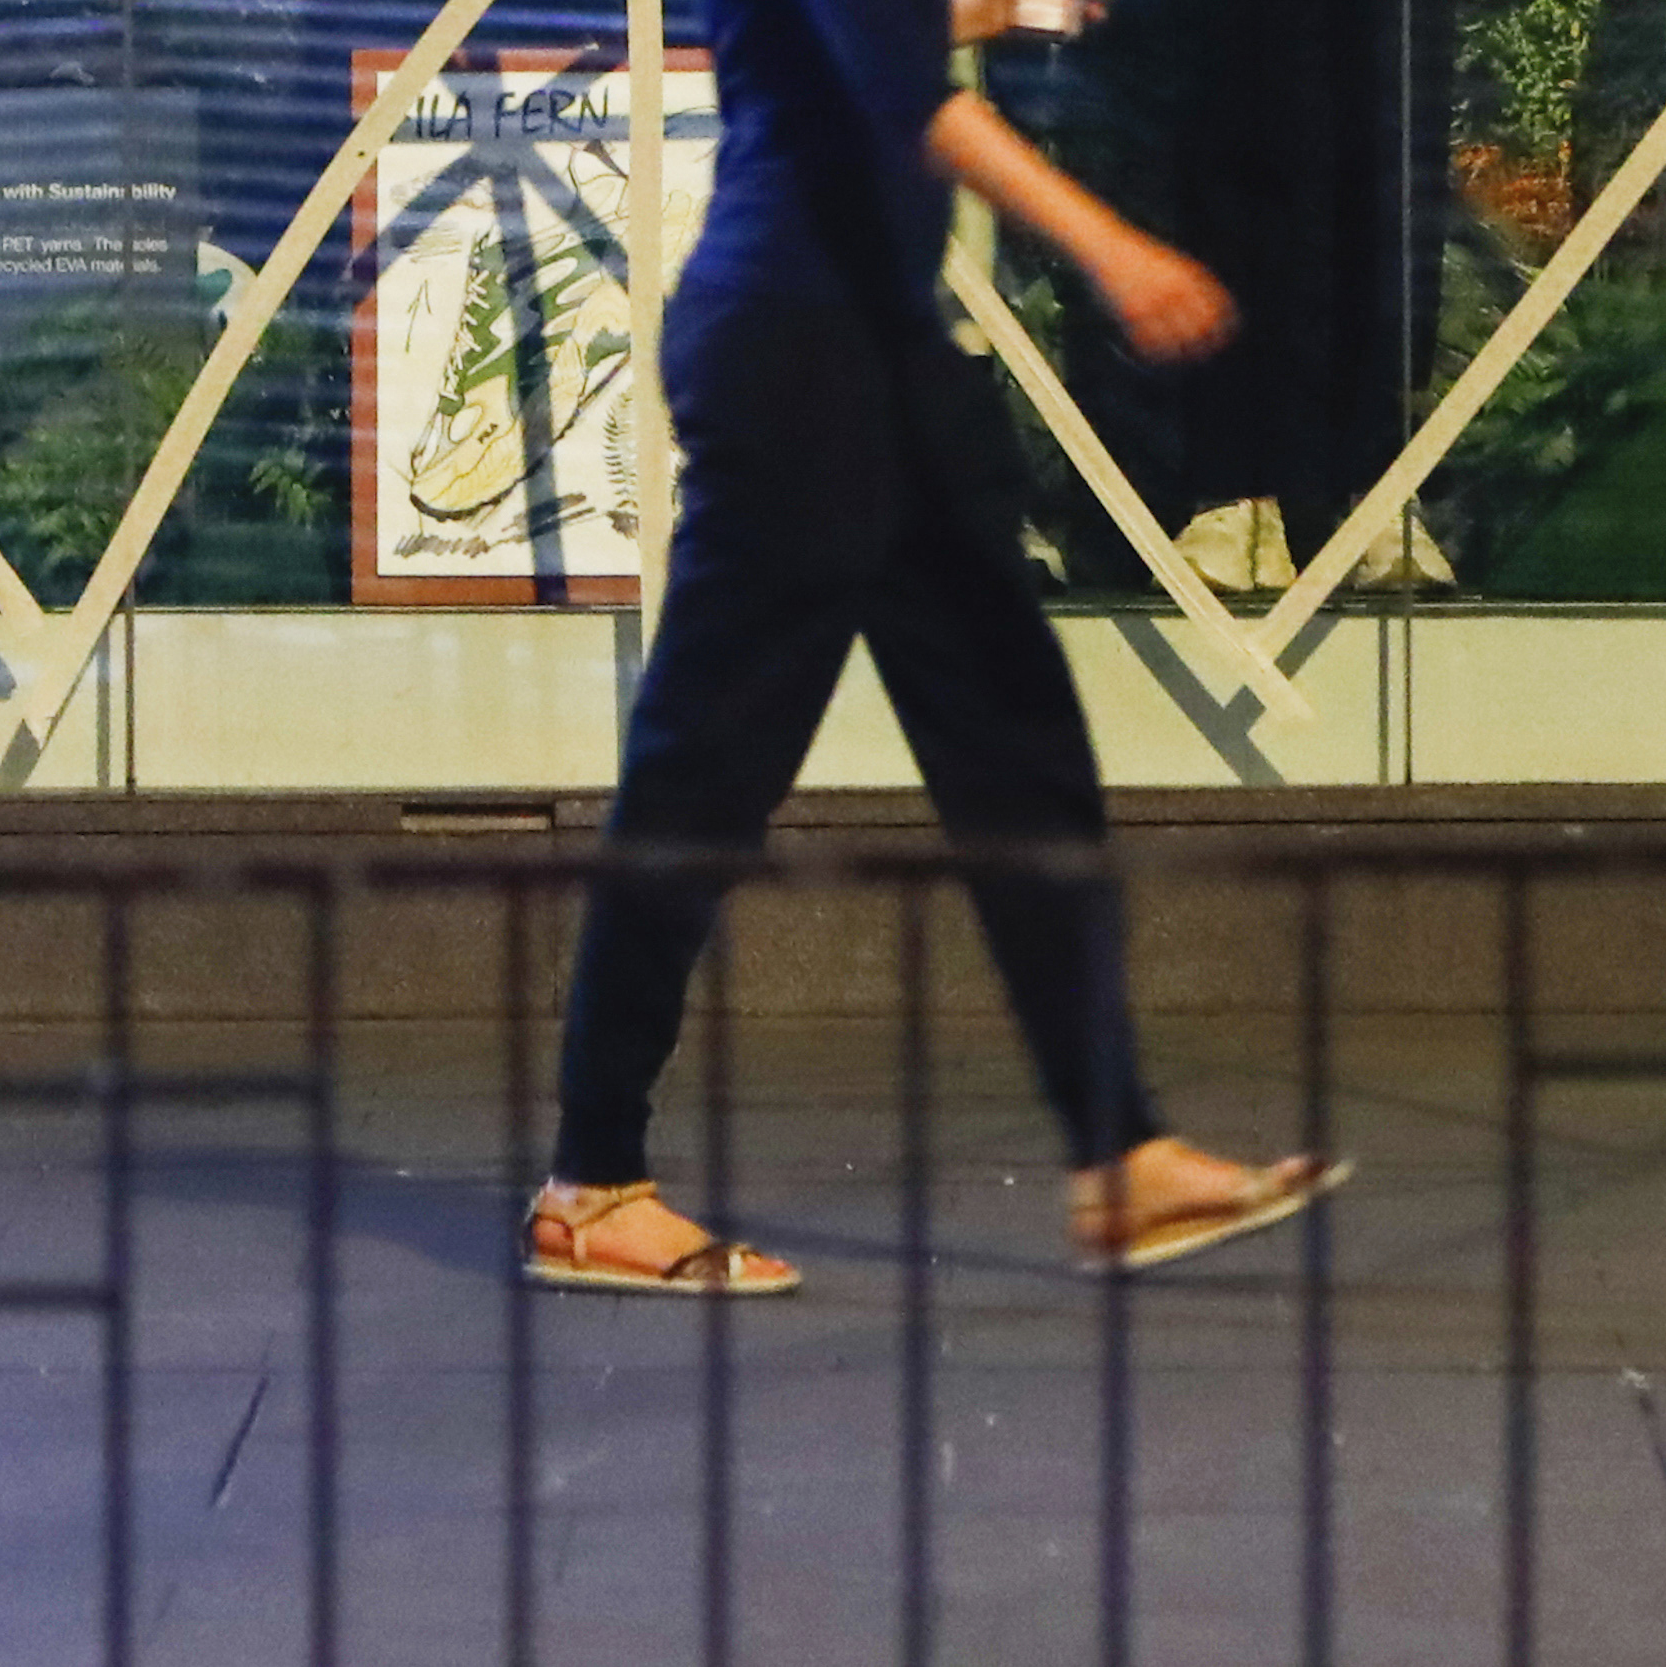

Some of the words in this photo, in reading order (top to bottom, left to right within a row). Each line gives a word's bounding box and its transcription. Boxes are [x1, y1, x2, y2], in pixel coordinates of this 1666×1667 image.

[415, 92, 473, 140] ILA
[495, 85, 608, 138] FERN
[3, 183, 45, 200] with
[2, 235, 34, 252] PET
[94, 236, 123, 252] The
[56, 257, 88, 273] EVA
